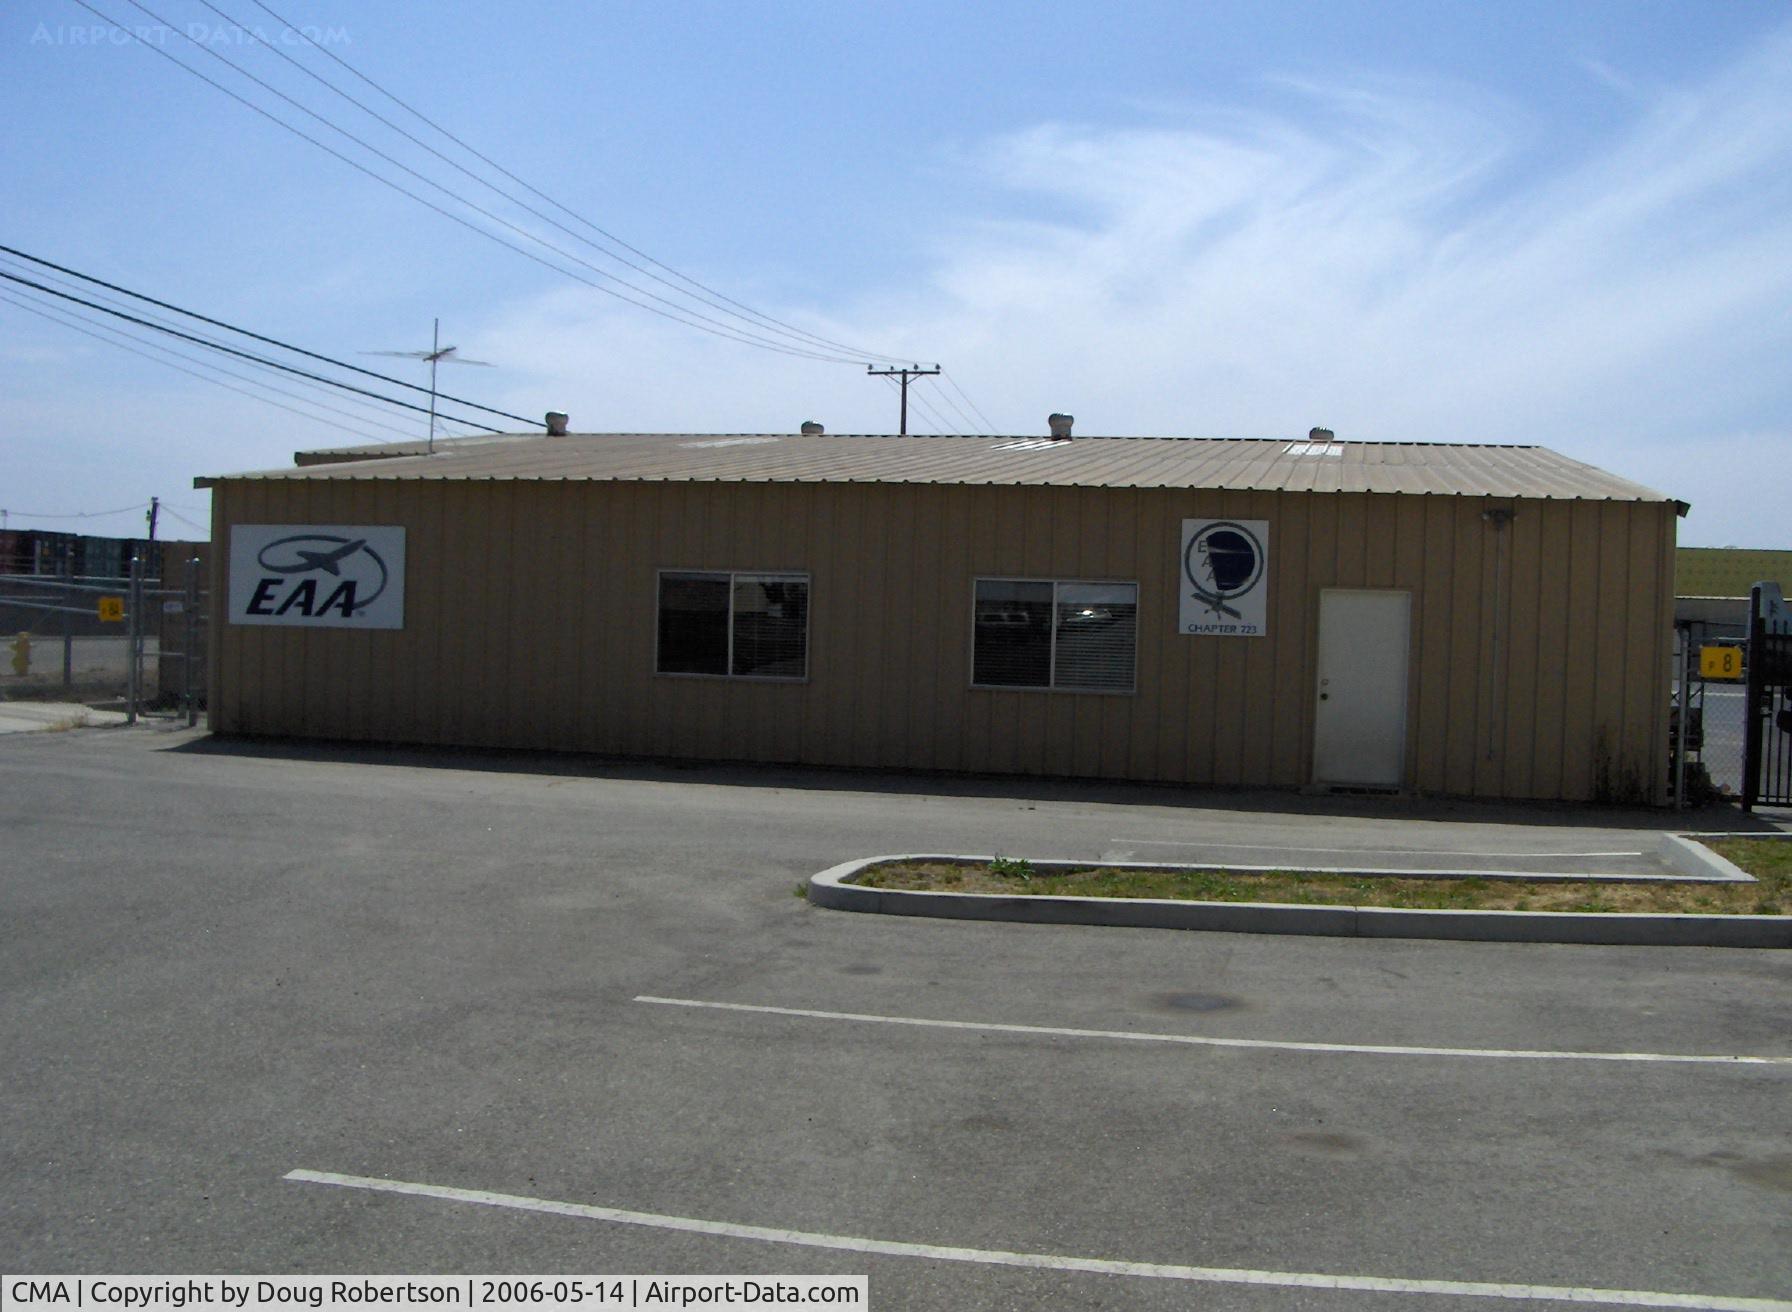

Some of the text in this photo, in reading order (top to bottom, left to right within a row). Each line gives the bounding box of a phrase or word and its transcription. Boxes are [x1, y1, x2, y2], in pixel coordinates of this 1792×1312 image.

[246, 578, 357, 618] EAA
[1188, 623, 1257, 634] CHAPTER 723
[1723, 653, 1732, 672] 8
